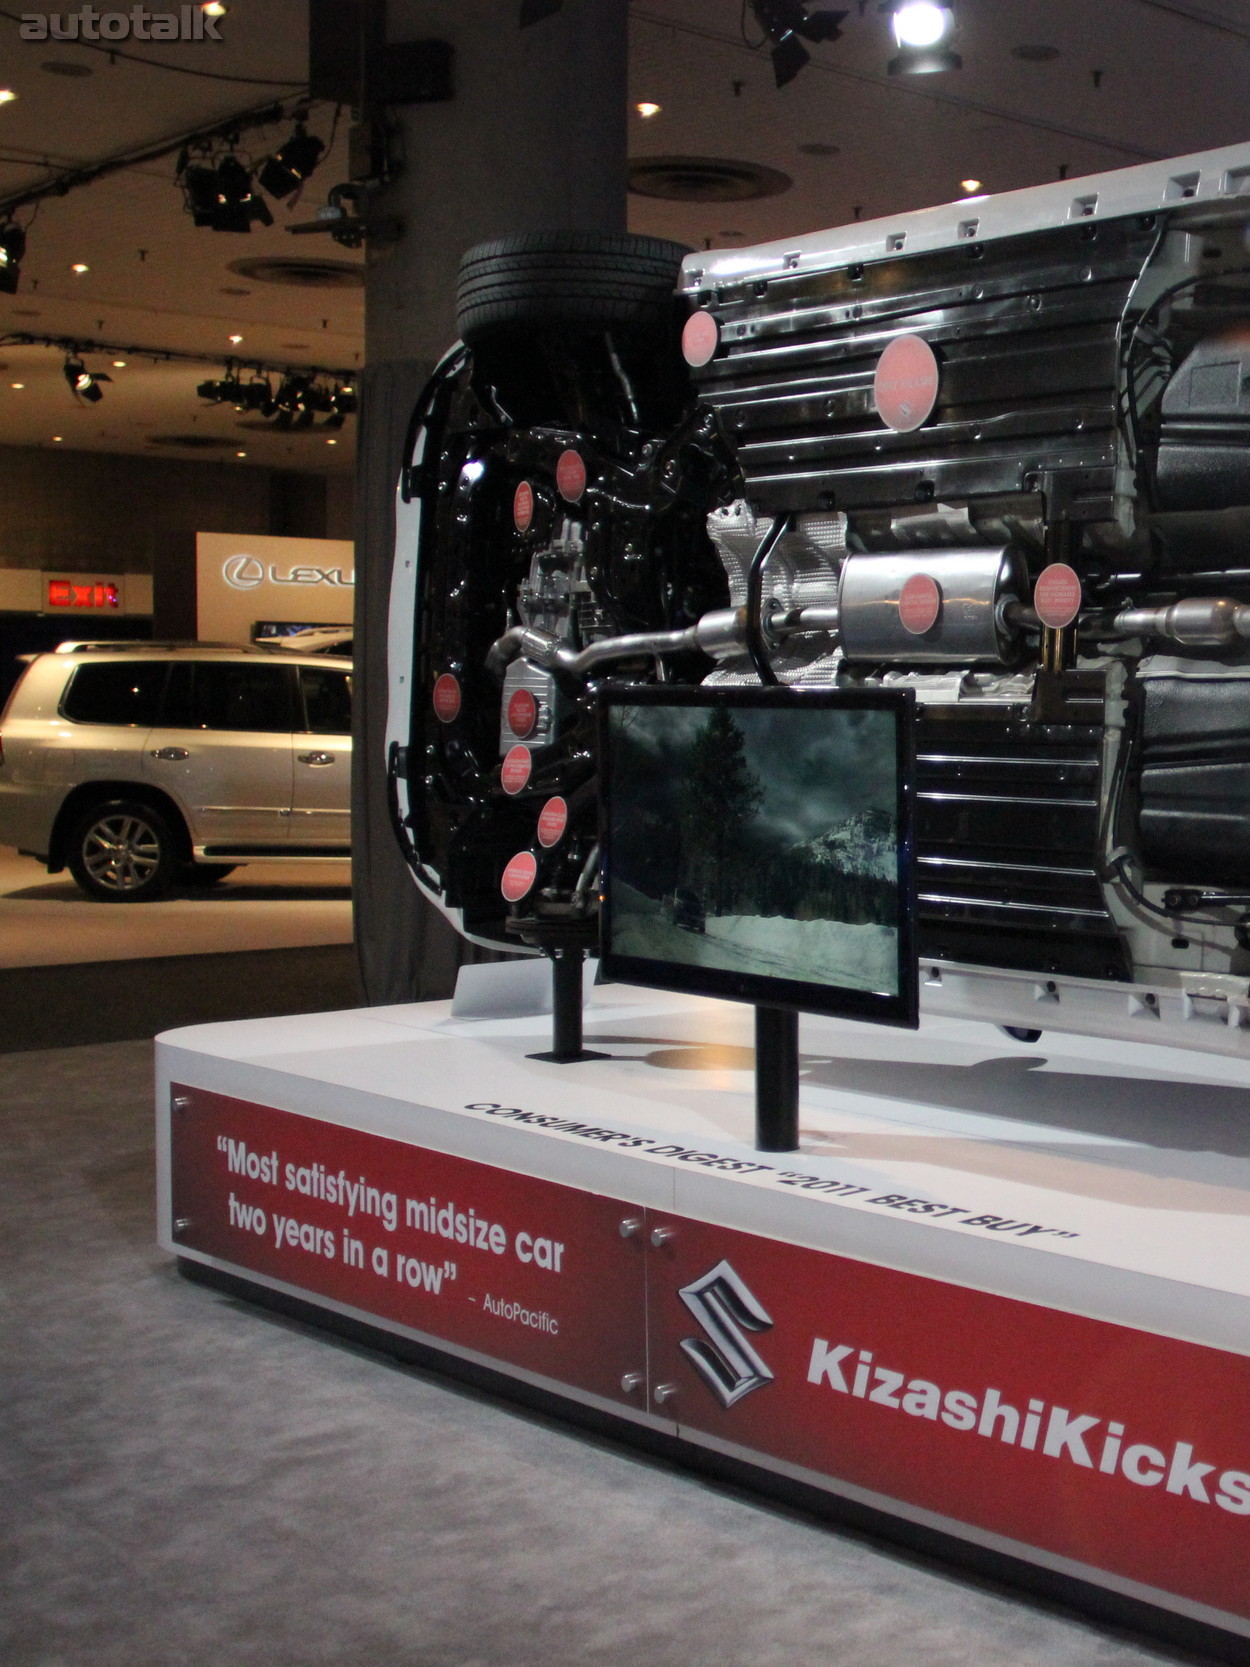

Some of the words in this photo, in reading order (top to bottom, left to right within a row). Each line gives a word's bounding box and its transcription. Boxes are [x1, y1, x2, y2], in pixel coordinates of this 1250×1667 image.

[269, 564, 355, 586] LEXU
[464, 1102, 656, 1149] CONSUMER'S
[642, 1144, 774, 1176] DIGEST
[865, 1193, 970, 1219] BEST
[228, 1193, 266, 1236] two
[272, 1212, 335, 1259] years
[343, 1229, 364, 1269] in
[371, 1250, 388, 1277] a
[285, 1161, 398, 1232] satisfying
[406, 1195, 506, 1255] midsize
[515, 1231, 564, 1273] car
[483, 1292, 559, 1335] AutoPacific
